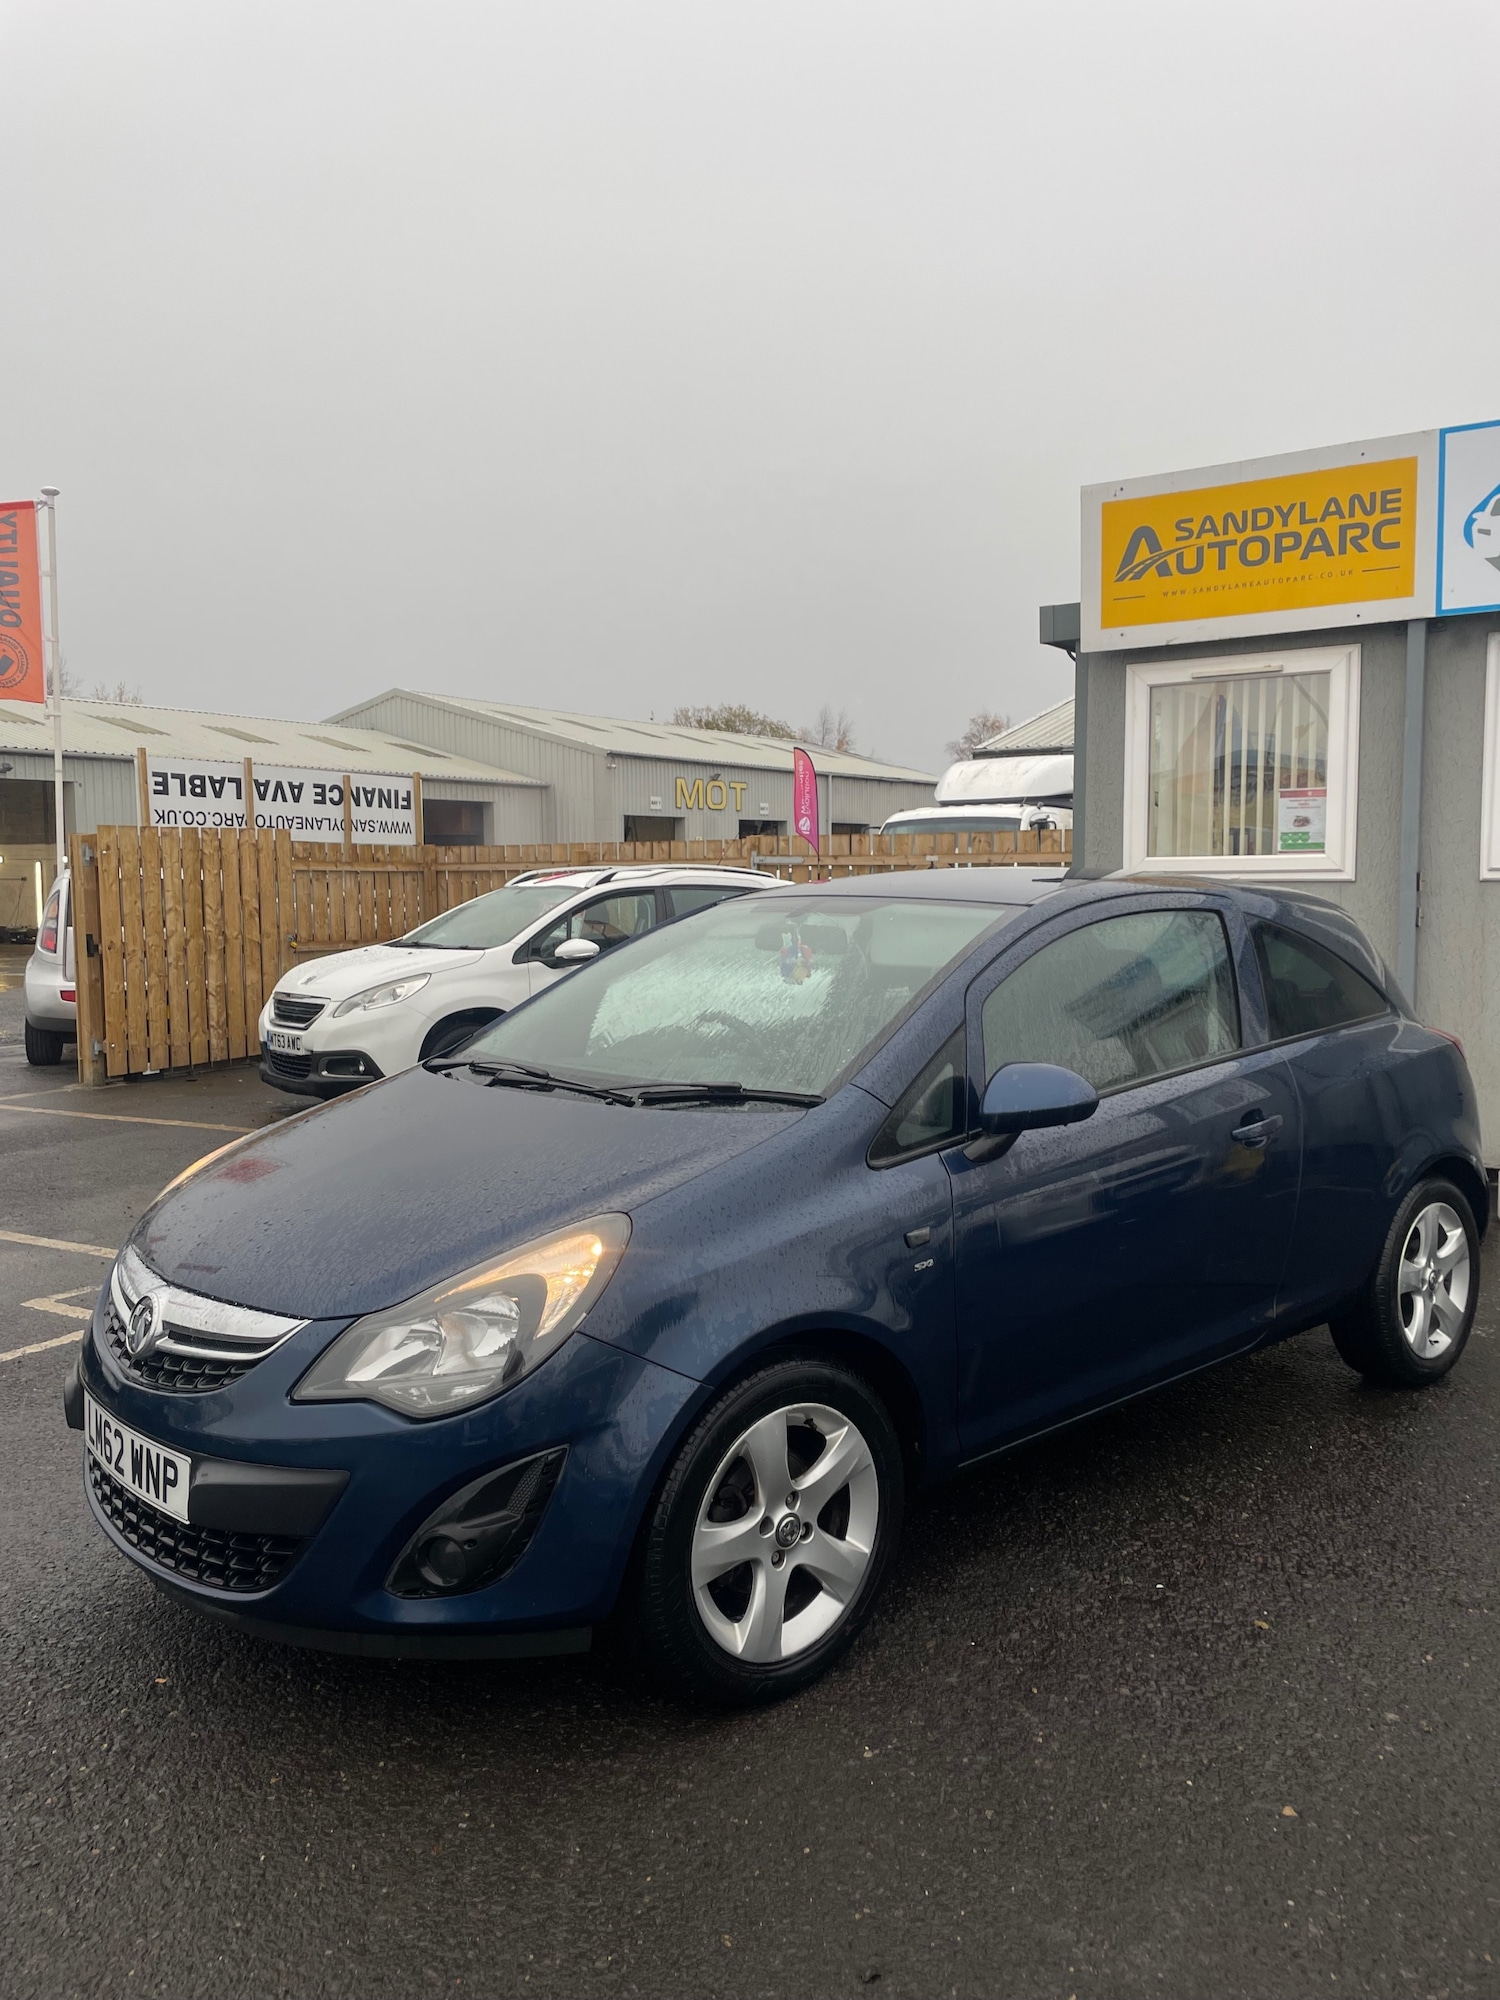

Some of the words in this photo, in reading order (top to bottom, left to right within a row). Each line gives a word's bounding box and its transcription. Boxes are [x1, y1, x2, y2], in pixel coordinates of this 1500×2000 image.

[1174, 487, 1402, 542] SANDYLANE
[1113, 517, 1402, 583] AUTOPARC
[1161, 567, 1355, 598] WWW.SANDYLANEAUTOPARC.CO.UK
[151, 770, 305, 804] AVALABLE
[313, 782, 412, 811] FINANCE
[675, 776, 748, 812] MOT
[88, 1398, 125, 1478] LM62
[130, 1438, 179, 1504] WNP
